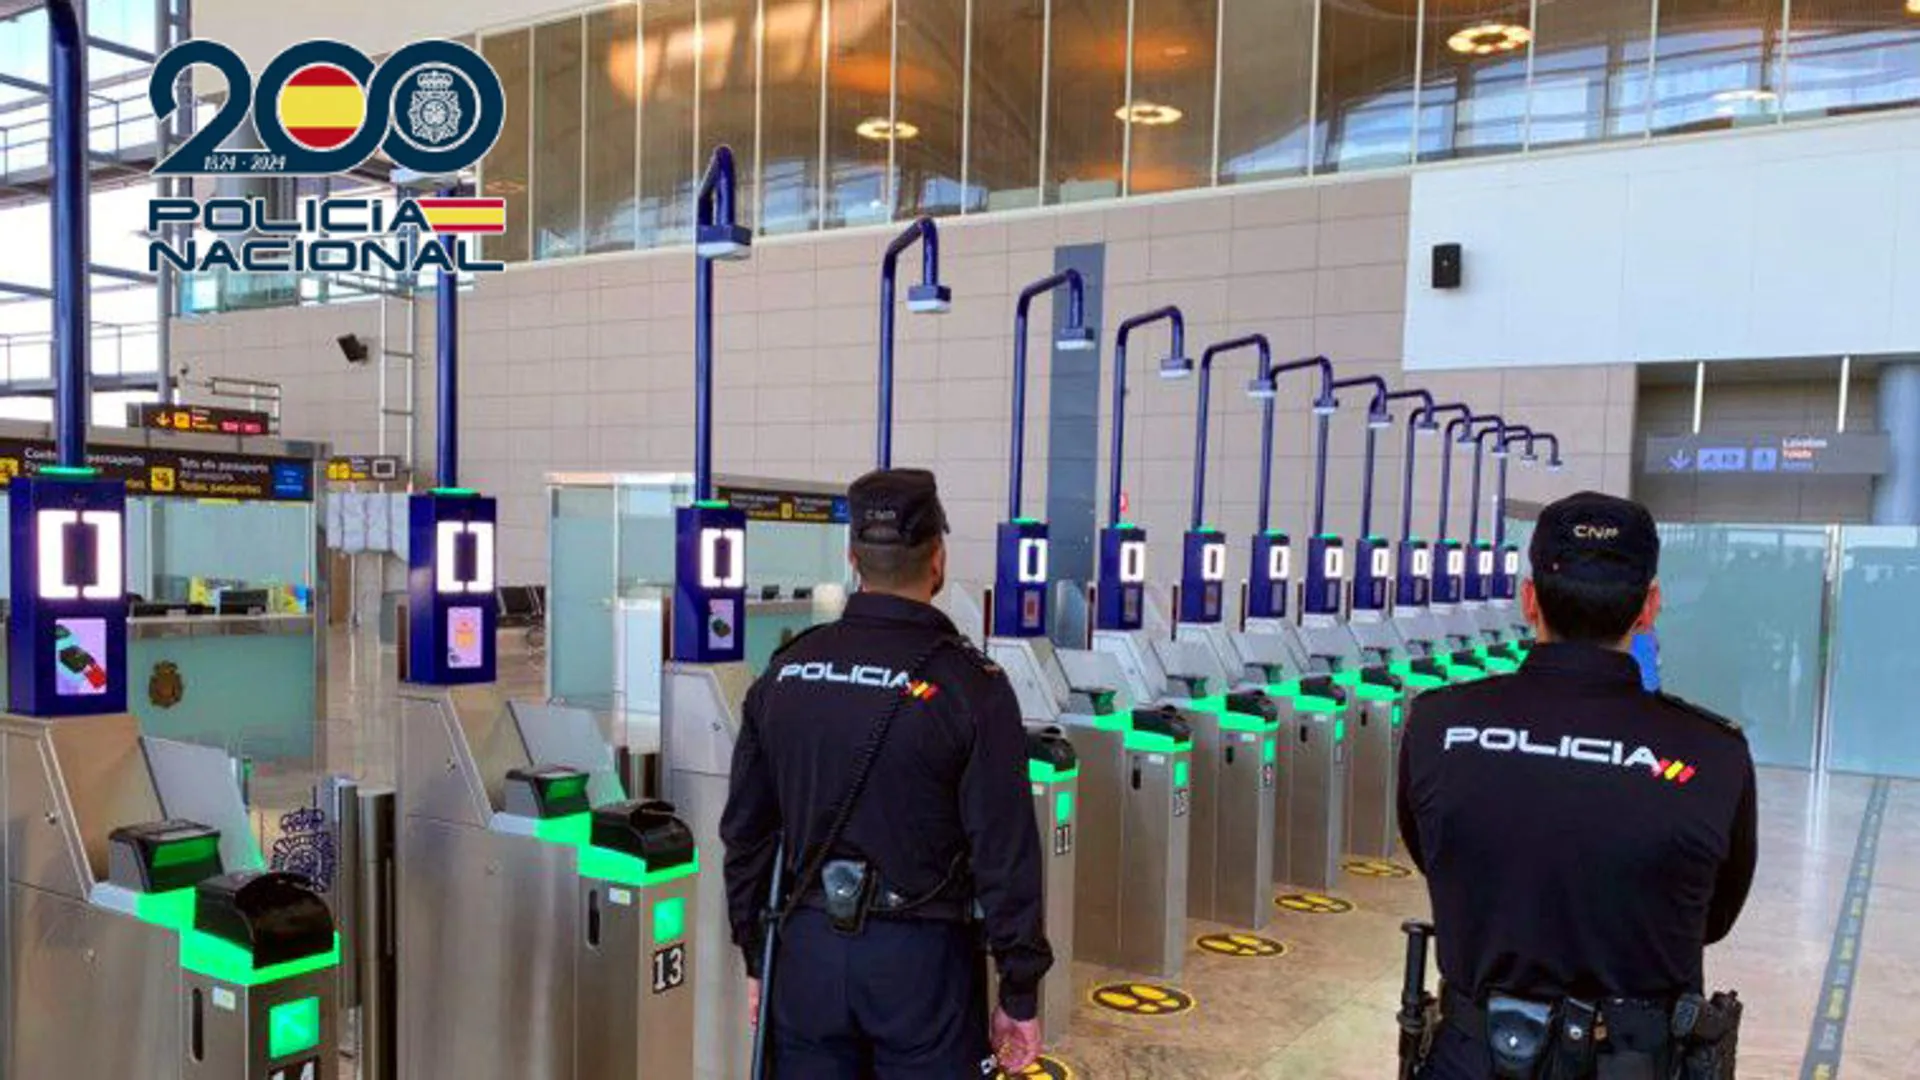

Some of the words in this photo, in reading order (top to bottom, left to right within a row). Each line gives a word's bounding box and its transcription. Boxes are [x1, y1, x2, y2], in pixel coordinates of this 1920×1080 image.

[776, 662, 911, 688] POLICIA
[1443, 726, 1661, 776] POLICIA
[654, 947, 682, 990] 13
